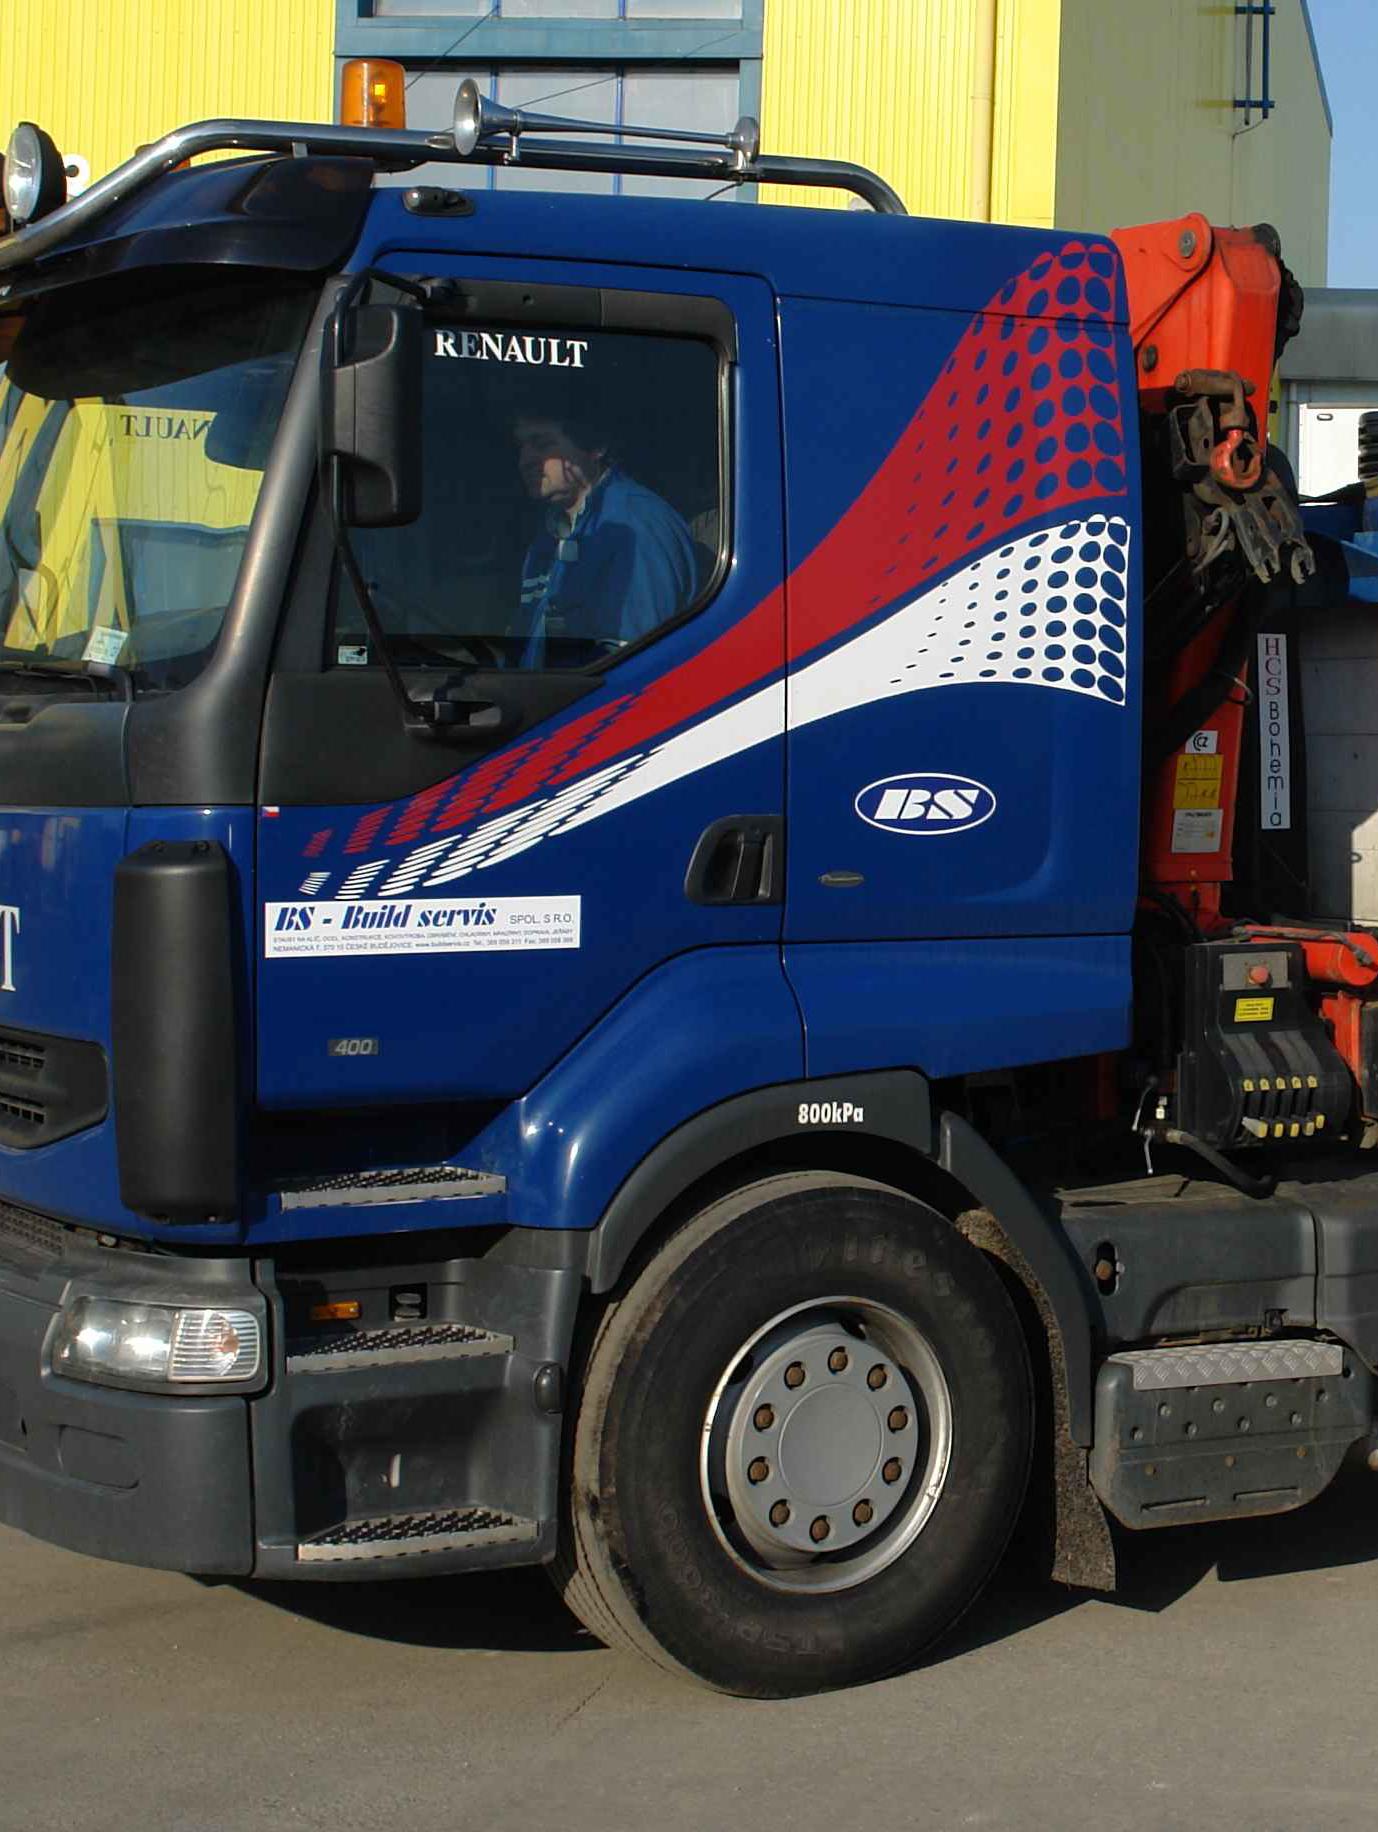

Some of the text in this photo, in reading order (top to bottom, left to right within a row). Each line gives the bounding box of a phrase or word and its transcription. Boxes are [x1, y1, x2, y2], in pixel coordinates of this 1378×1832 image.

[433, 328, 588, 368] RENAULT
[873, 788, 980, 820] BS
[274, 905, 315, 931] BS
[340, 904, 413, 930] Build
[416, 902, 498, 928] servis
[334, 1039, 373, 1056] 400
[797, 1101, 864, 1124] 800kPa
